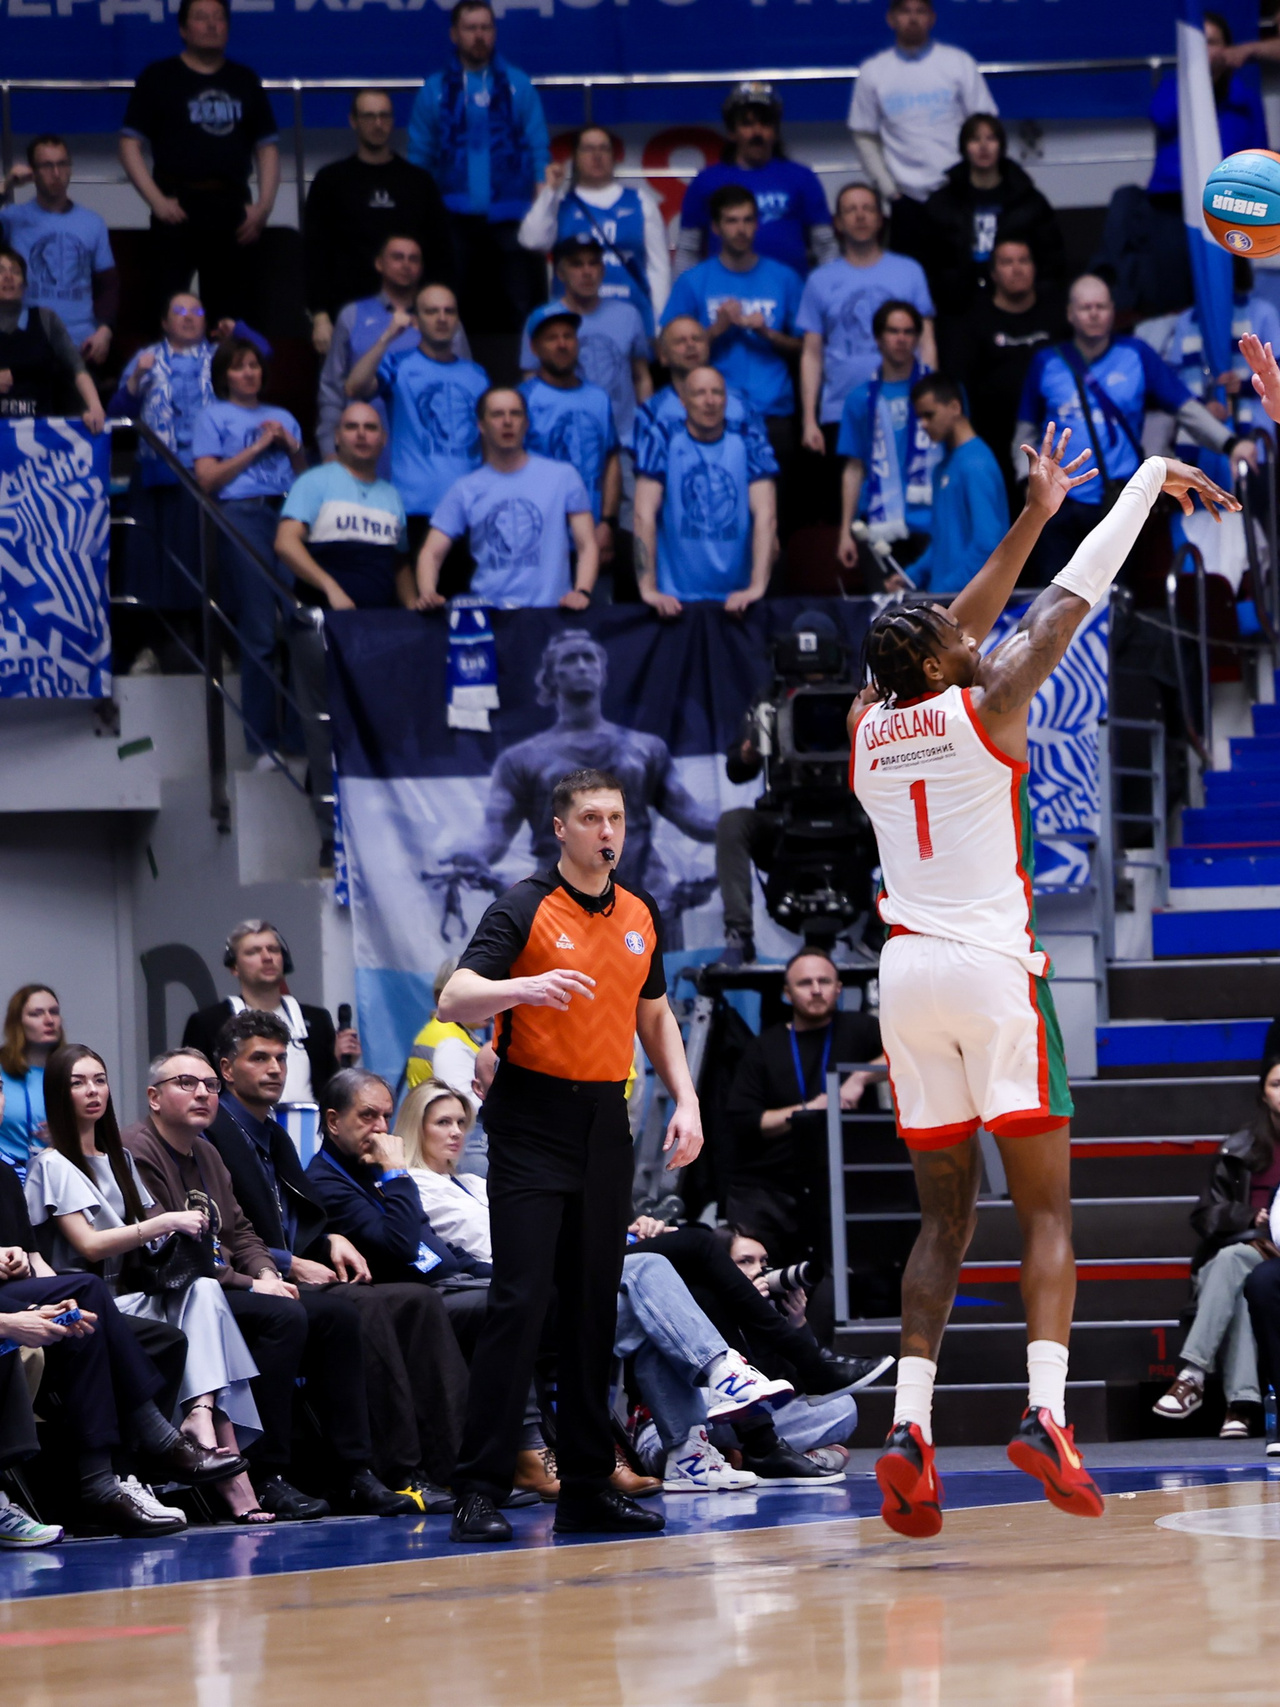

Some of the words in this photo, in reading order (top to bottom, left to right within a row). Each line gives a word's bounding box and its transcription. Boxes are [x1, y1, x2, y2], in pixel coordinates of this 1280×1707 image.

[1212, 194, 1268, 217] SIBUR
[863, 709, 946, 751] CLEVELAND
[881, 742, 955, 766] БЛАГОСОСТОЯНИЕ
[910, 779, 933, 861] 1
[1151, 1327, 1166, 1360] 1
